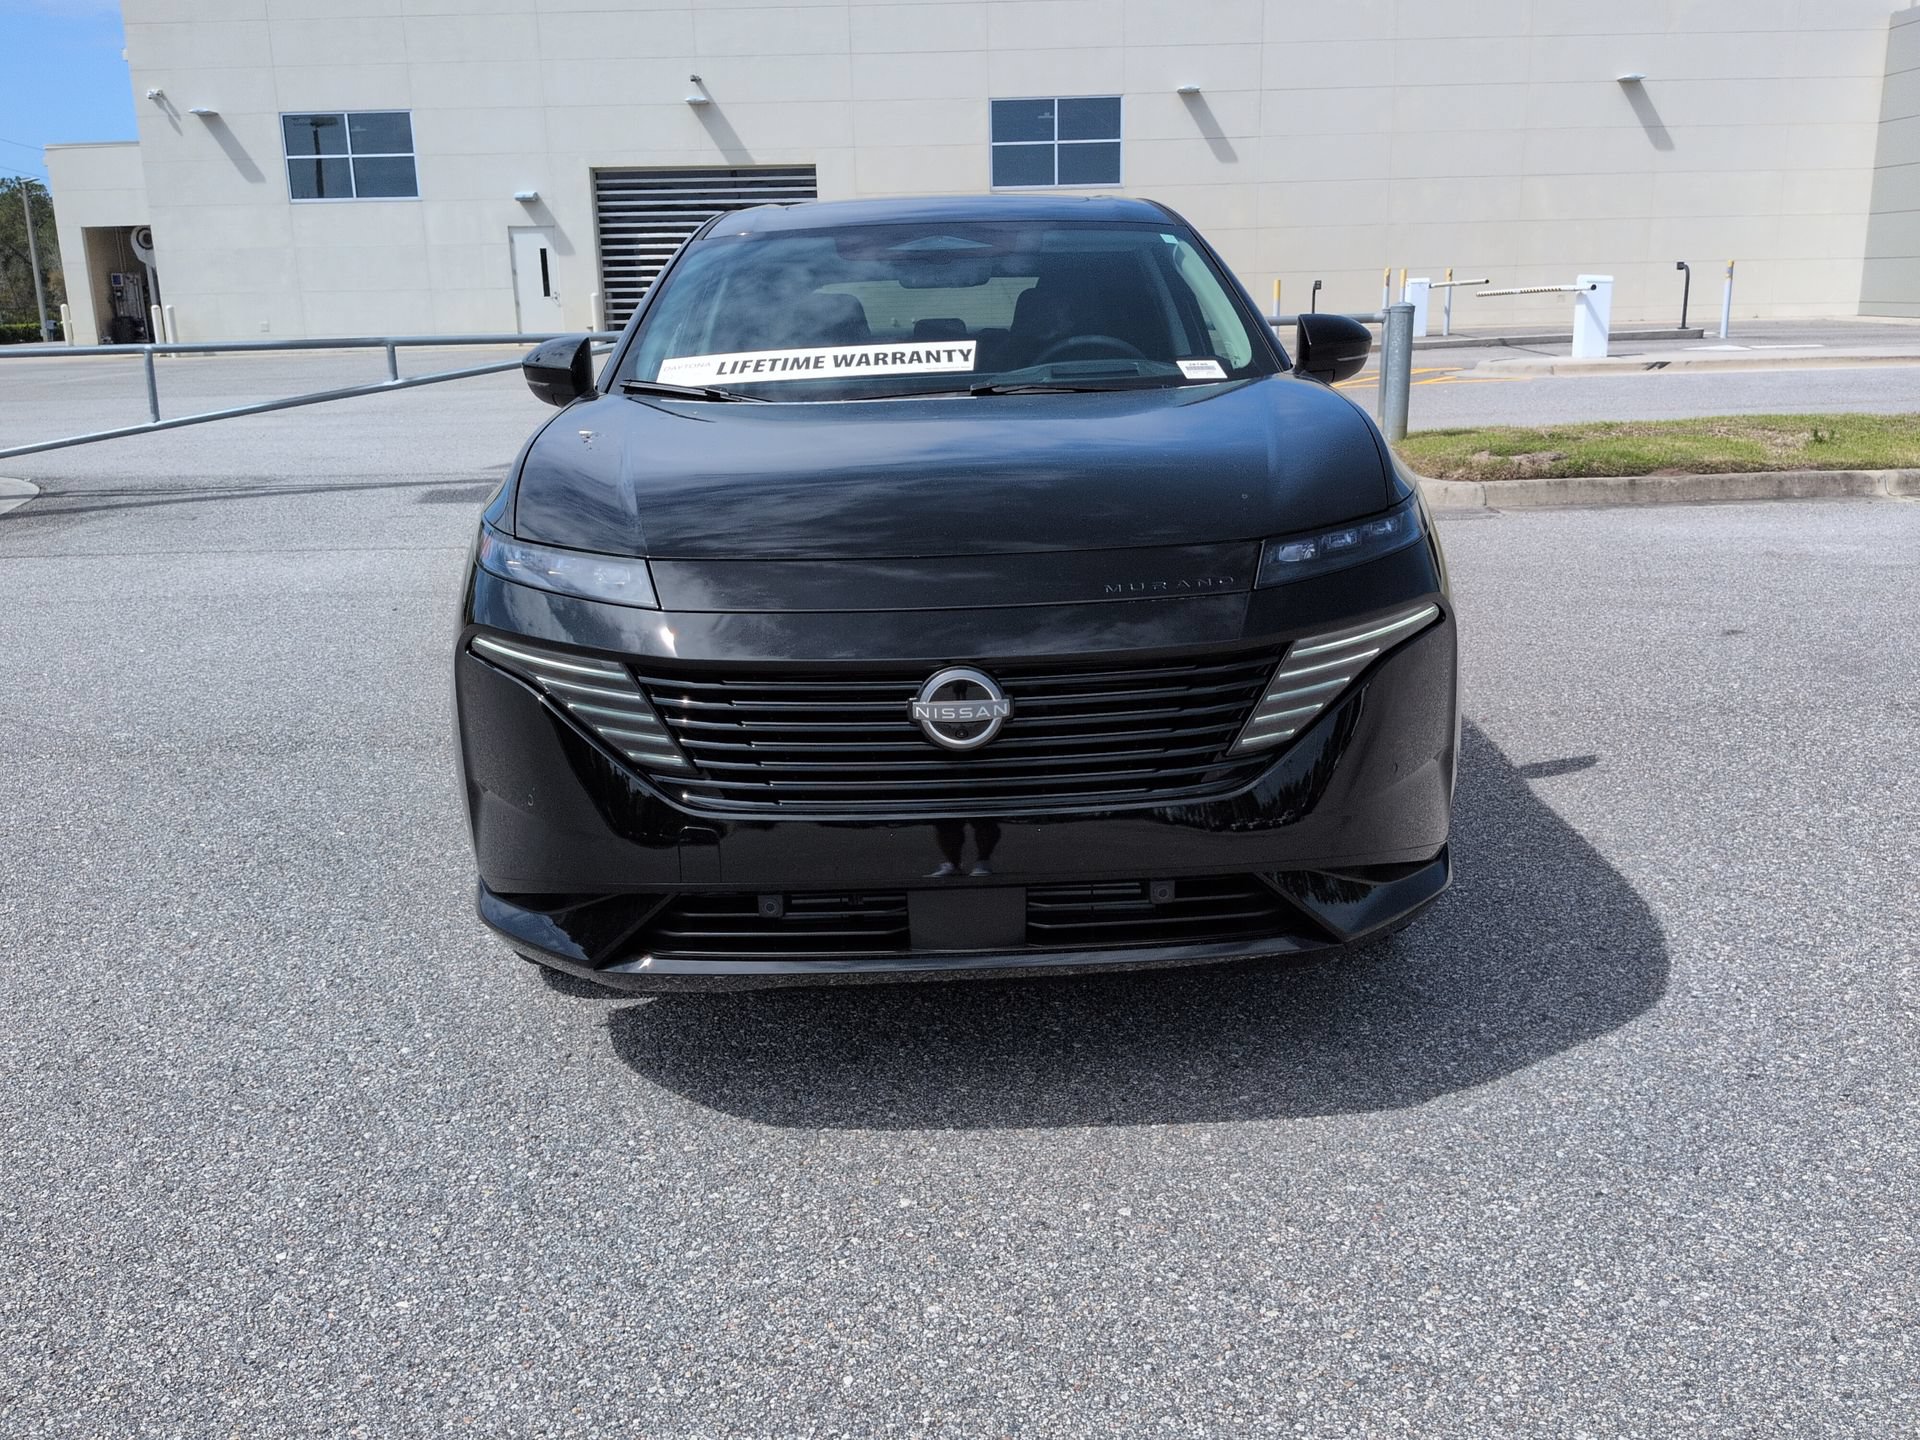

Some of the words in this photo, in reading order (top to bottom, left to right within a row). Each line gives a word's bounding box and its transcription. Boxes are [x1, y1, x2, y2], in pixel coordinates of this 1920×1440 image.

[716, 356, 825, 376] LIFETIME
[833, 348, 973, 369] WARRANTY
[1105, 576, 1234, 592] MURANO
[915, 703, 1008, 719] NISSAN
